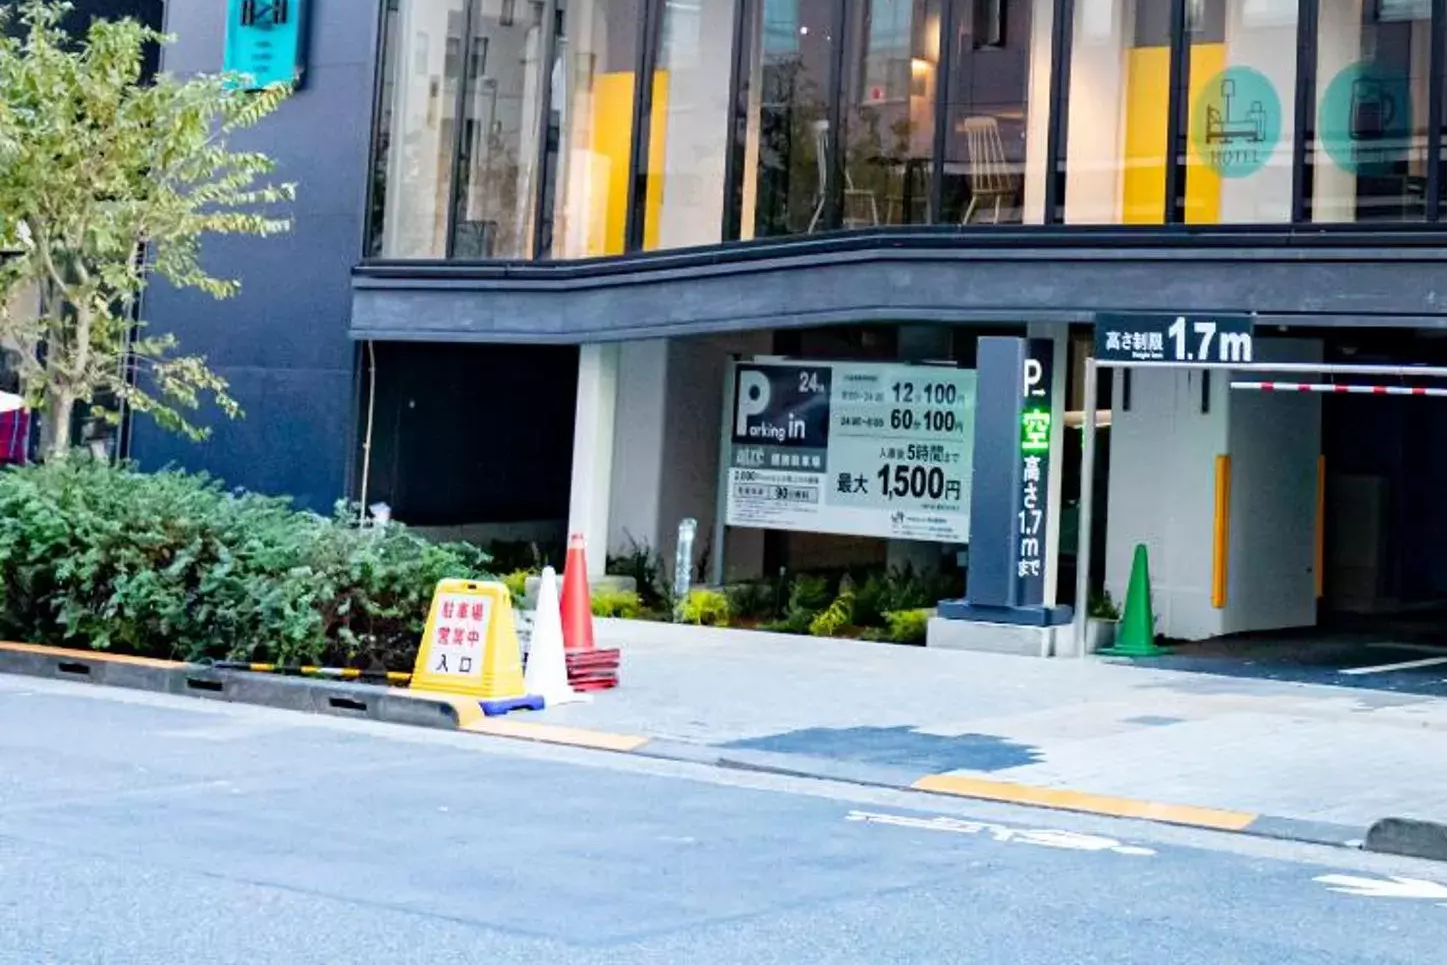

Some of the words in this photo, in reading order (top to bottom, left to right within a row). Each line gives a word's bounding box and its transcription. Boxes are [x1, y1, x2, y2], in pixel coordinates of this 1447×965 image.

[1211, 149, 1260, 165] HOTEL
[1105, 331, 1163, 351] 高さ制限
[1024, 359, 1042, 397] P
[788, 412, 806, 439] in
[1022, 409, 1050, 449] 空
[837, 472, 868, 494] 最大
[877, 464, 961, 501] 1,500円
[441, 601, 484, 622] 駐車場
[438, 627, 480, 648] 営業中
[435, 654, 472, 673] 入口
